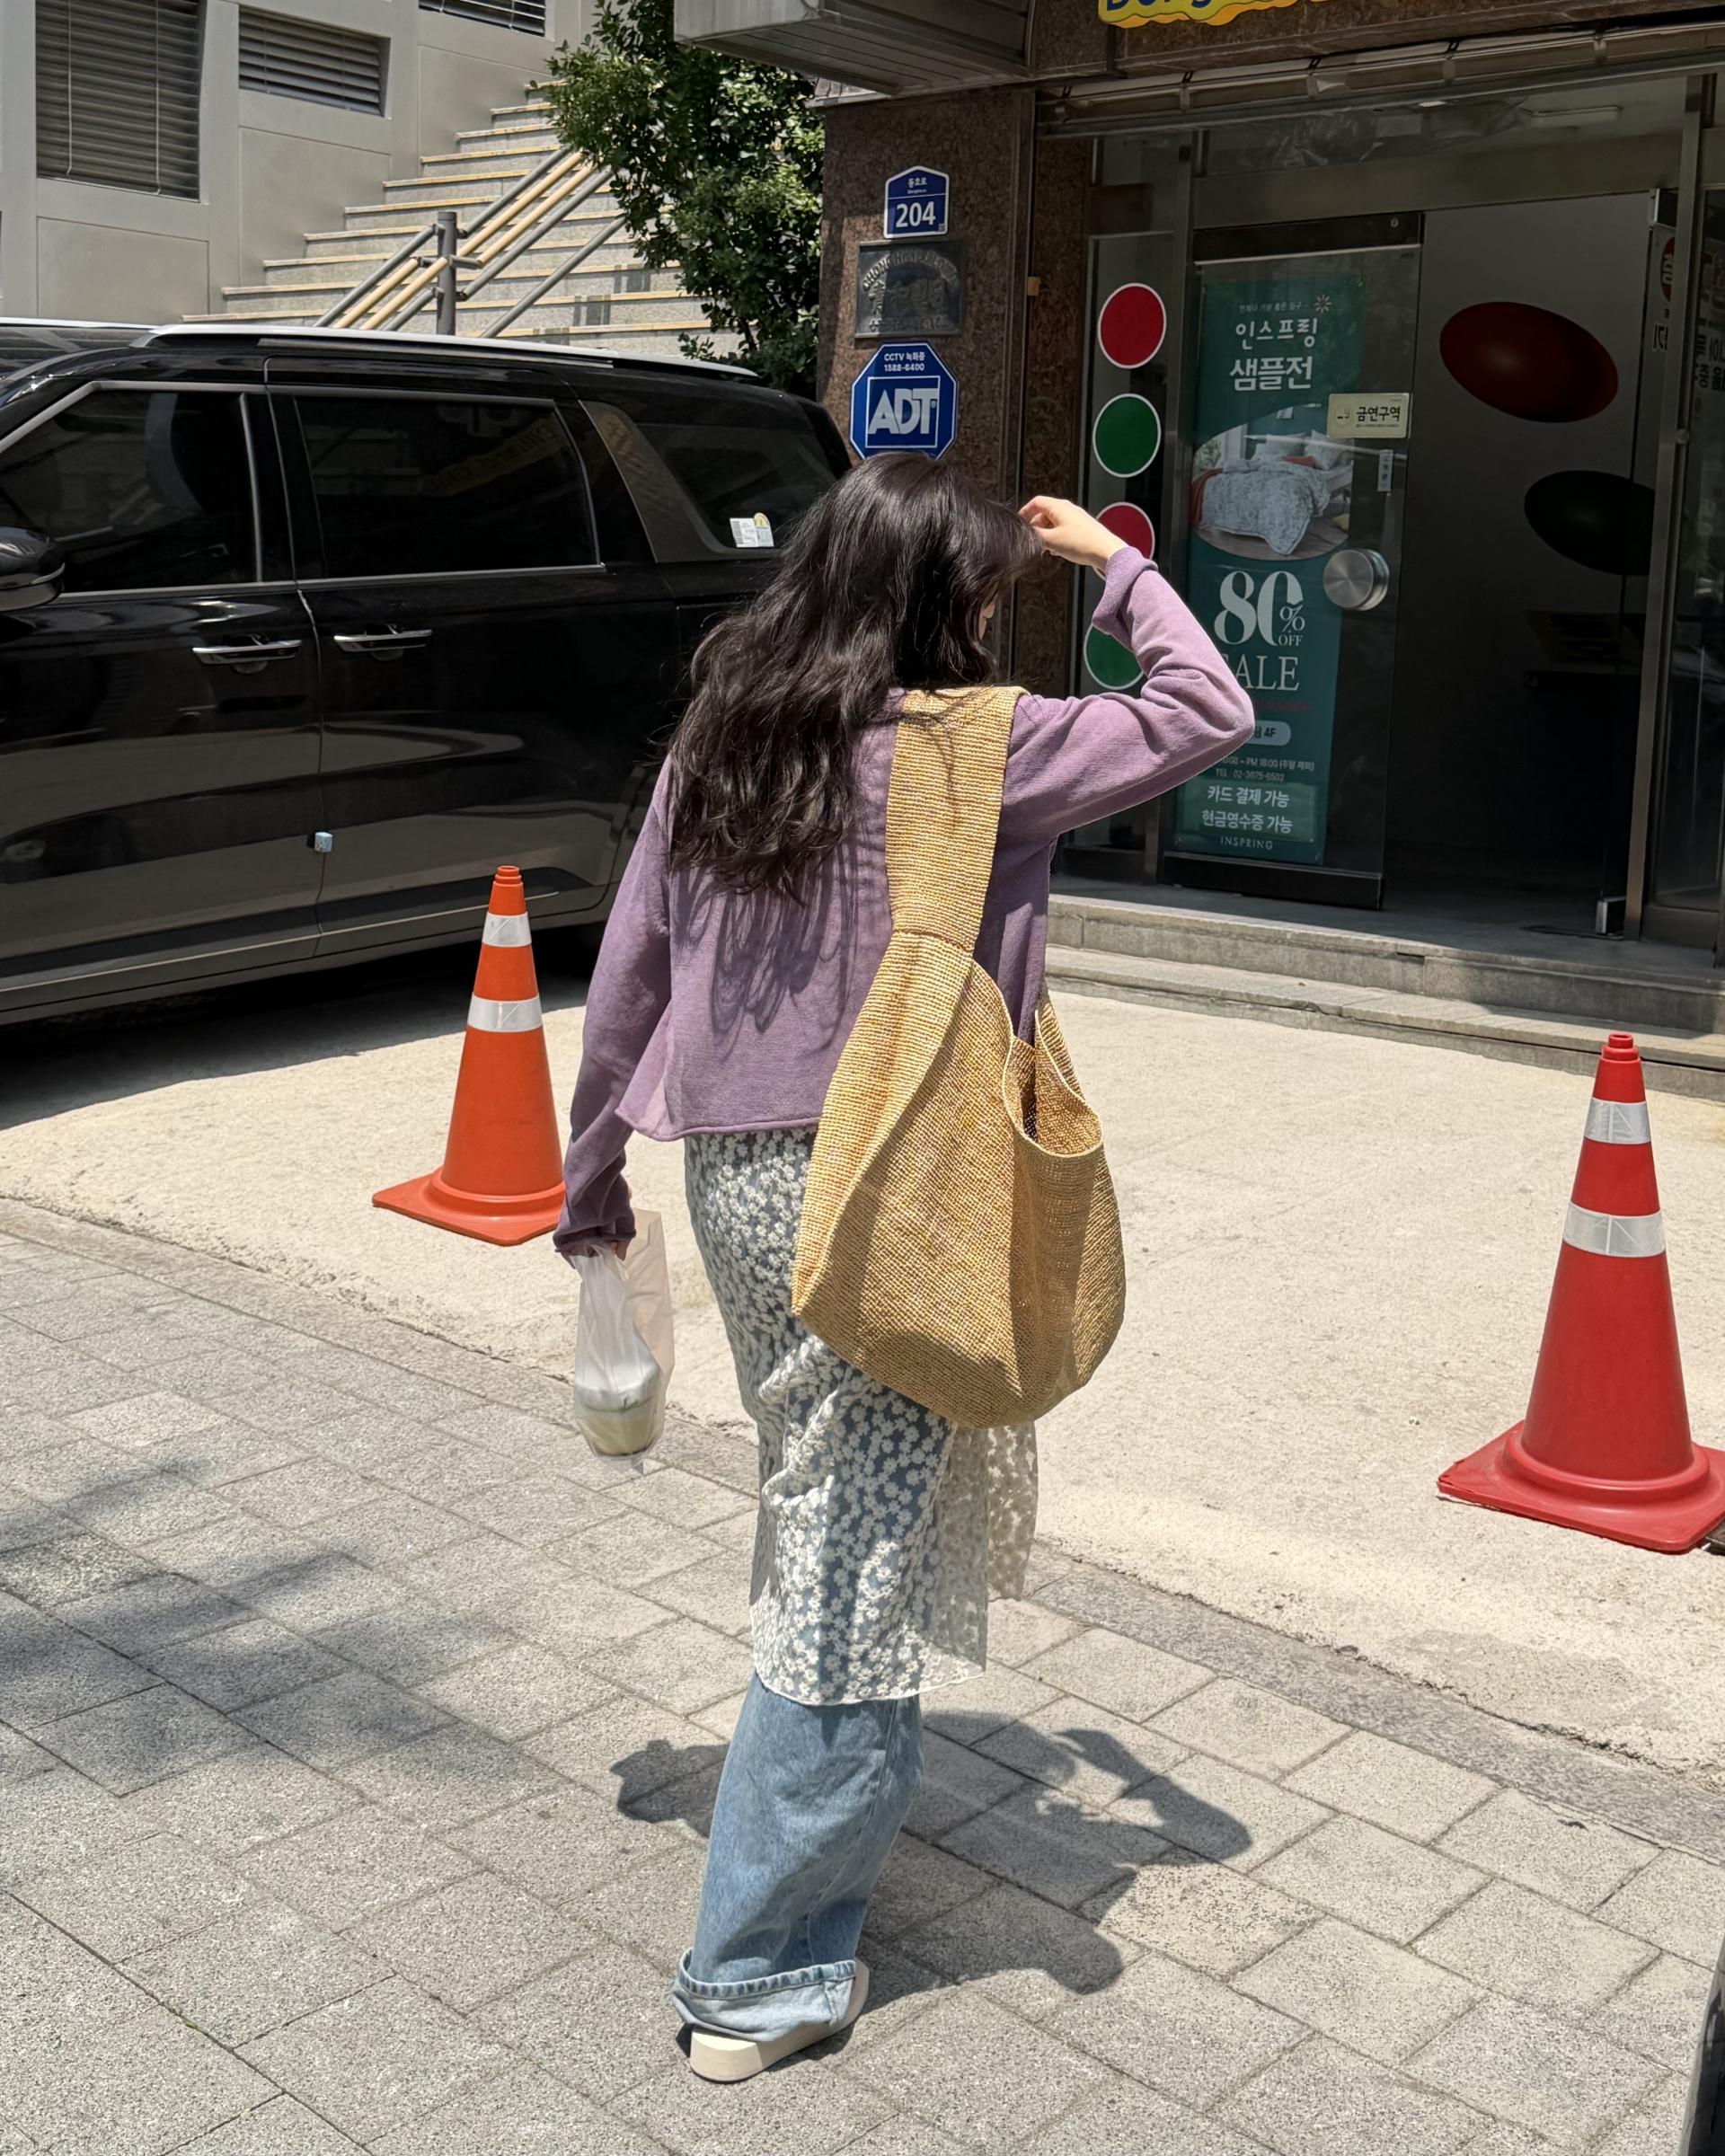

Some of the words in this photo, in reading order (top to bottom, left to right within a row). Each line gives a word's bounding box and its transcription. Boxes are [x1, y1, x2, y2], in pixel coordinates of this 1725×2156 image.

[895, 201, 935, 227] 204
[1235, 318, 1317, 349] 인스프링
[884, 353, 904, 361] CCTV
[1230, 357, 1313, 391] 샘플전
[868, 388, 938, 434] ADT
[1356, 406, 1401, 421] 금연구역
[1278, 634, 1303, 646] OFF
[1264, 727, 1277, 738] 4F
[1208, 785, 1233, 802] 카드
[1236, 787, 1261, 805] 결제
[1264, 791, 1290, 808] 가능
[1202, 809, 1264, 831] 현금영수증
[1267, 815, 1293, 835] 가능
[1220, 836, 1273, 850] INSPRING
